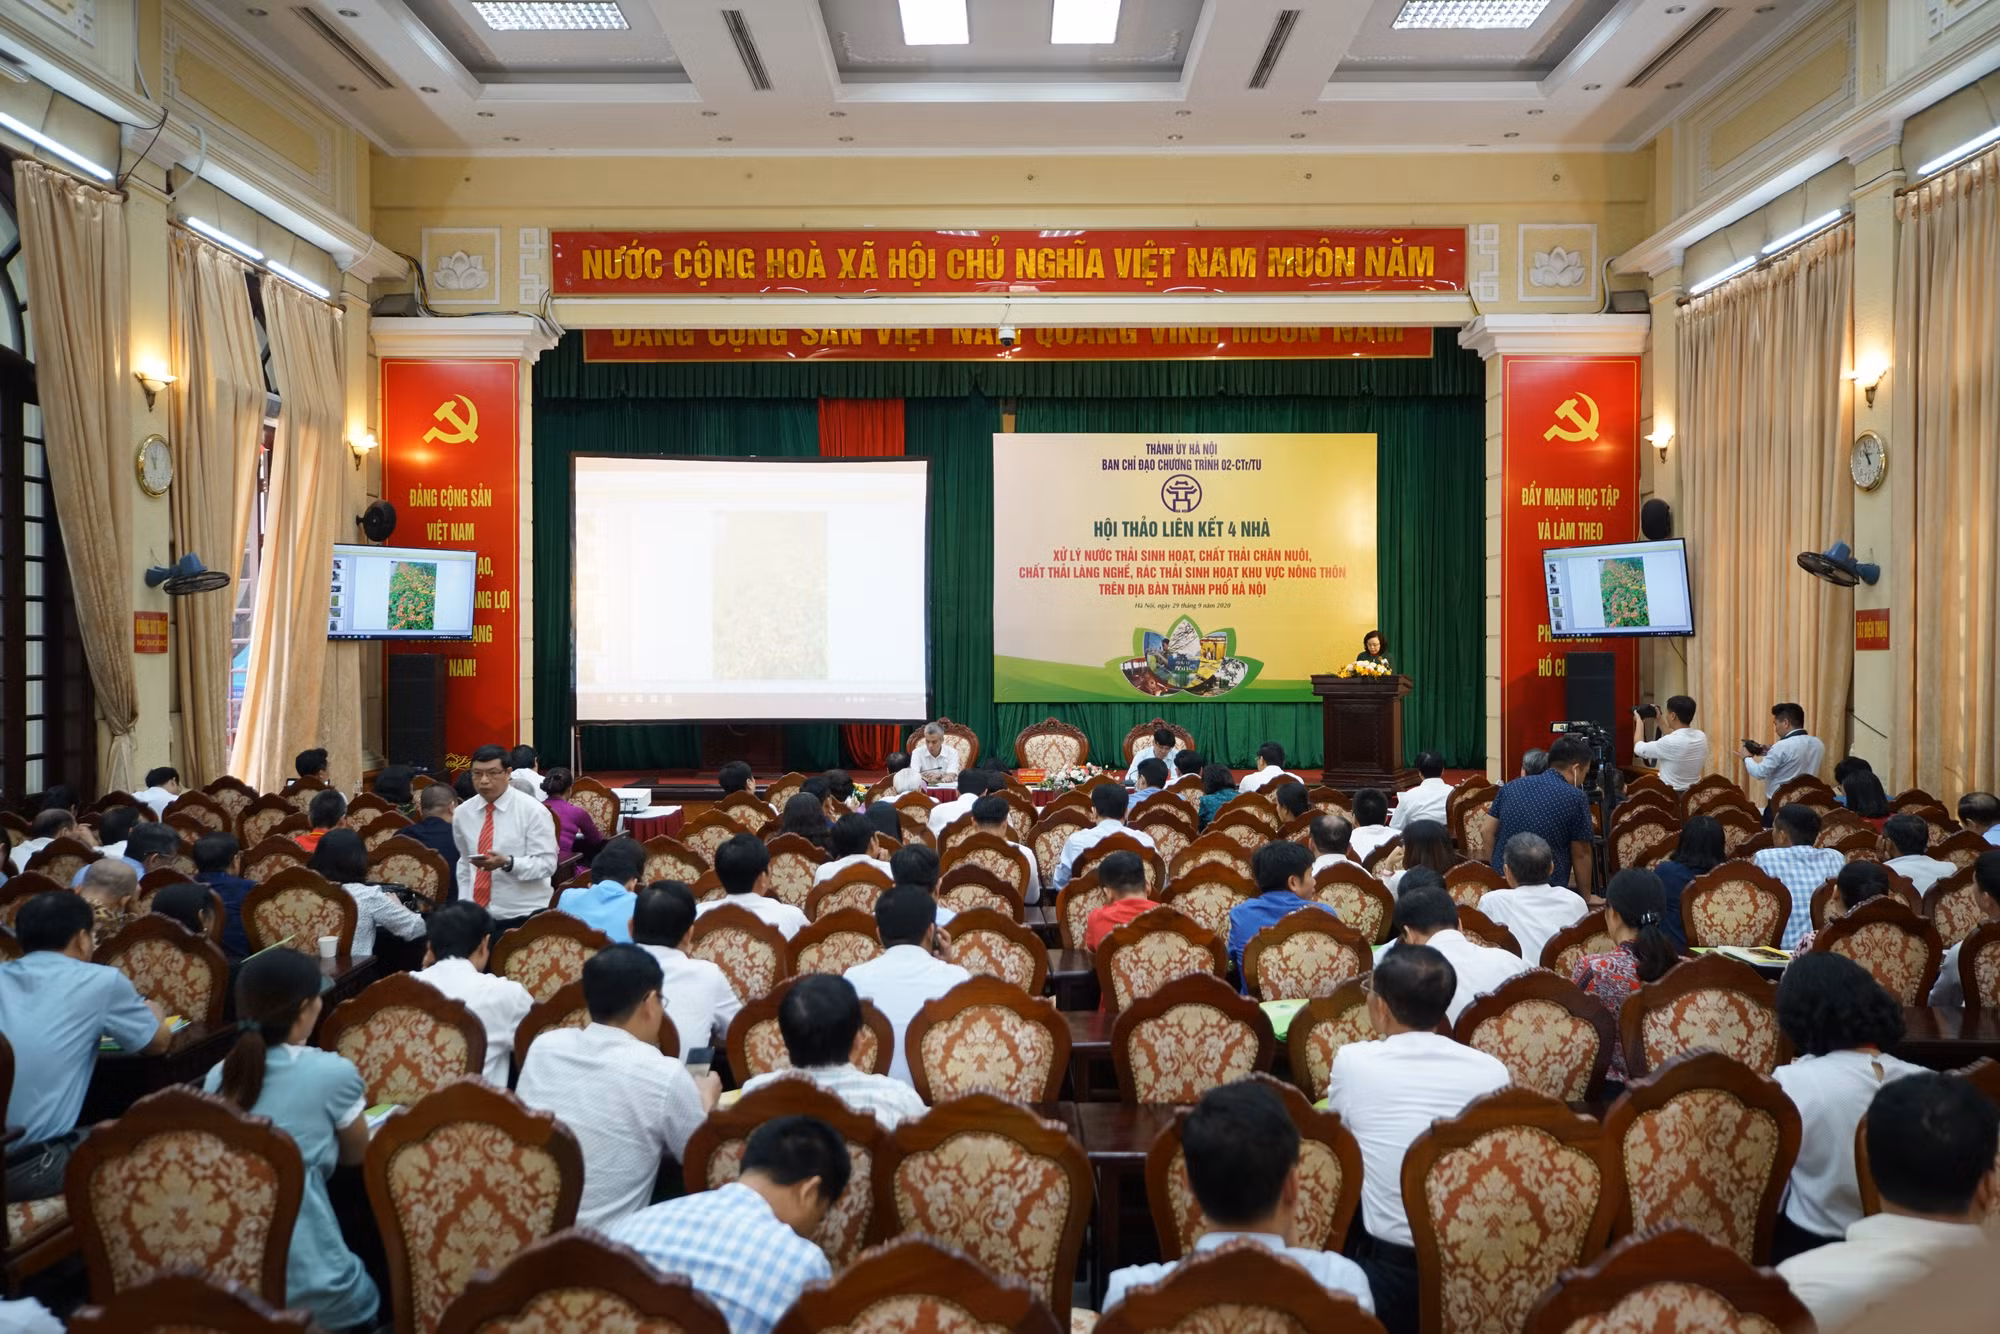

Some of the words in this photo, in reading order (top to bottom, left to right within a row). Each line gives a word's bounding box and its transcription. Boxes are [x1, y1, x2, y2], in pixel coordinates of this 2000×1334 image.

[582, 240, 663, 280] NƯỚC
[674, 241, 755, 287] CỘNG
[767, 240, 826, 280] HOÀ
[838, 241, 878, 280] XÃ
[888, 241, 936, 287] HỘI
[947, 235, 1005, 280] CHỦ
[1016, 240, 1104, 279] NGHĨA
[1114, 240, 1176, 286] VIỆT
[1187, 247, 1257, 278] NAM
[1268, 239, 1355, 278] MUÔN
[1365, 237, 1434, 277] NĂM
[1146, 441, 1173, 455] THÀNH
[1176, 440, 1187, 455] ỦY
[1189, 441, 1200, 455] HÀ
[1203, 441, 1217, 457] NỘI
[1102, 459, 1119, 470] BAN
[1122, 456, 1136, 470] CHỈ
[1138, 459, 1155, 473] ĐẠO
[1158, 457, 1192, 471] CHƯƠNG
[1194, 456, 1219, 470] TRÌNH
[1221, 459, 1262, 471] 02-CTr/TU
[410, 483, 437, 507] ĐẢNG
[440, 485, 468, 511] CỘNG
[471, 483, 492, 507] SẢN
[1544, 488, 1575, 510] MẠNH
[1577, 488, 1598, 510] HỌC
[1601, 485, 1620, 510] TẬP
[427, 519, 448, 544] VIỆT
[451, 523, 475, 541] NAM
[1094, 518, 1117, 540] HỘI
[1122, 516, 1158, 537] THẢO
[1163, 518, 1194, 537] LIÊN
[1198, 516, 1224, 537] KẾT
[1228, 521, 1236, 537] 4
[1241, 518, 1270, 537] NHÀ
[1538, 518, 1551, 540] VÀ
[1554, 518, 1575, 540] LÀM
[1578, 522, 1603, 540] THEO
[1053, 546, 1068, 561] XỬ
[1070, 548, 1081, 561] LÝ
[1084, 547, 1112, 561] NƯỚC
[1115, 546, 1137, 561] THẢI
[1141, 550, 1165, 561] SINH
[1169, 550, 1196, 564] HOẠT,
[1199, 546, 1225, 561] CHẤT
[1228, 546, 1250, 561] THẢI
[1253, 547, 1281, 561] CHĂN
[1285, 547, 1312, 562] NUÔI,
[477, 556, 494, 579] ẠO,
[1019, 563, 1045, 578] CHẤT
[1048, 563, 1070, 578] THẢI
[1074, 564, 1100, 578] LÀNG
[1136, 564, 1157, 578] RÁC
[1160, 563, 1182, 578] THẢI
[1185, 567, 1210, 578] SINH
[1242, 567, 1262, 578] KHU
[1265, 566, 1285, 581] VỰC
[1288, 564, 1316, 578] NÔNG
[1320, 565, 1346, 578] THÔN
[1099, 581, 1124, 595] TRÊN
[1128, 584, 1145, 597] ĐỊA
[1148, 581, 1169, 595] BÀN
[1172, 581, 1205, 595] THÀNH
[1208, 579, 1229, 595] PHỐ
[1232, 581, 1246, 595] HÀ
[1248, 581, 1266, 597] NỘI
[494, 589, 510, 613] LỢI
[449, 659, 476, 677] NAM!
